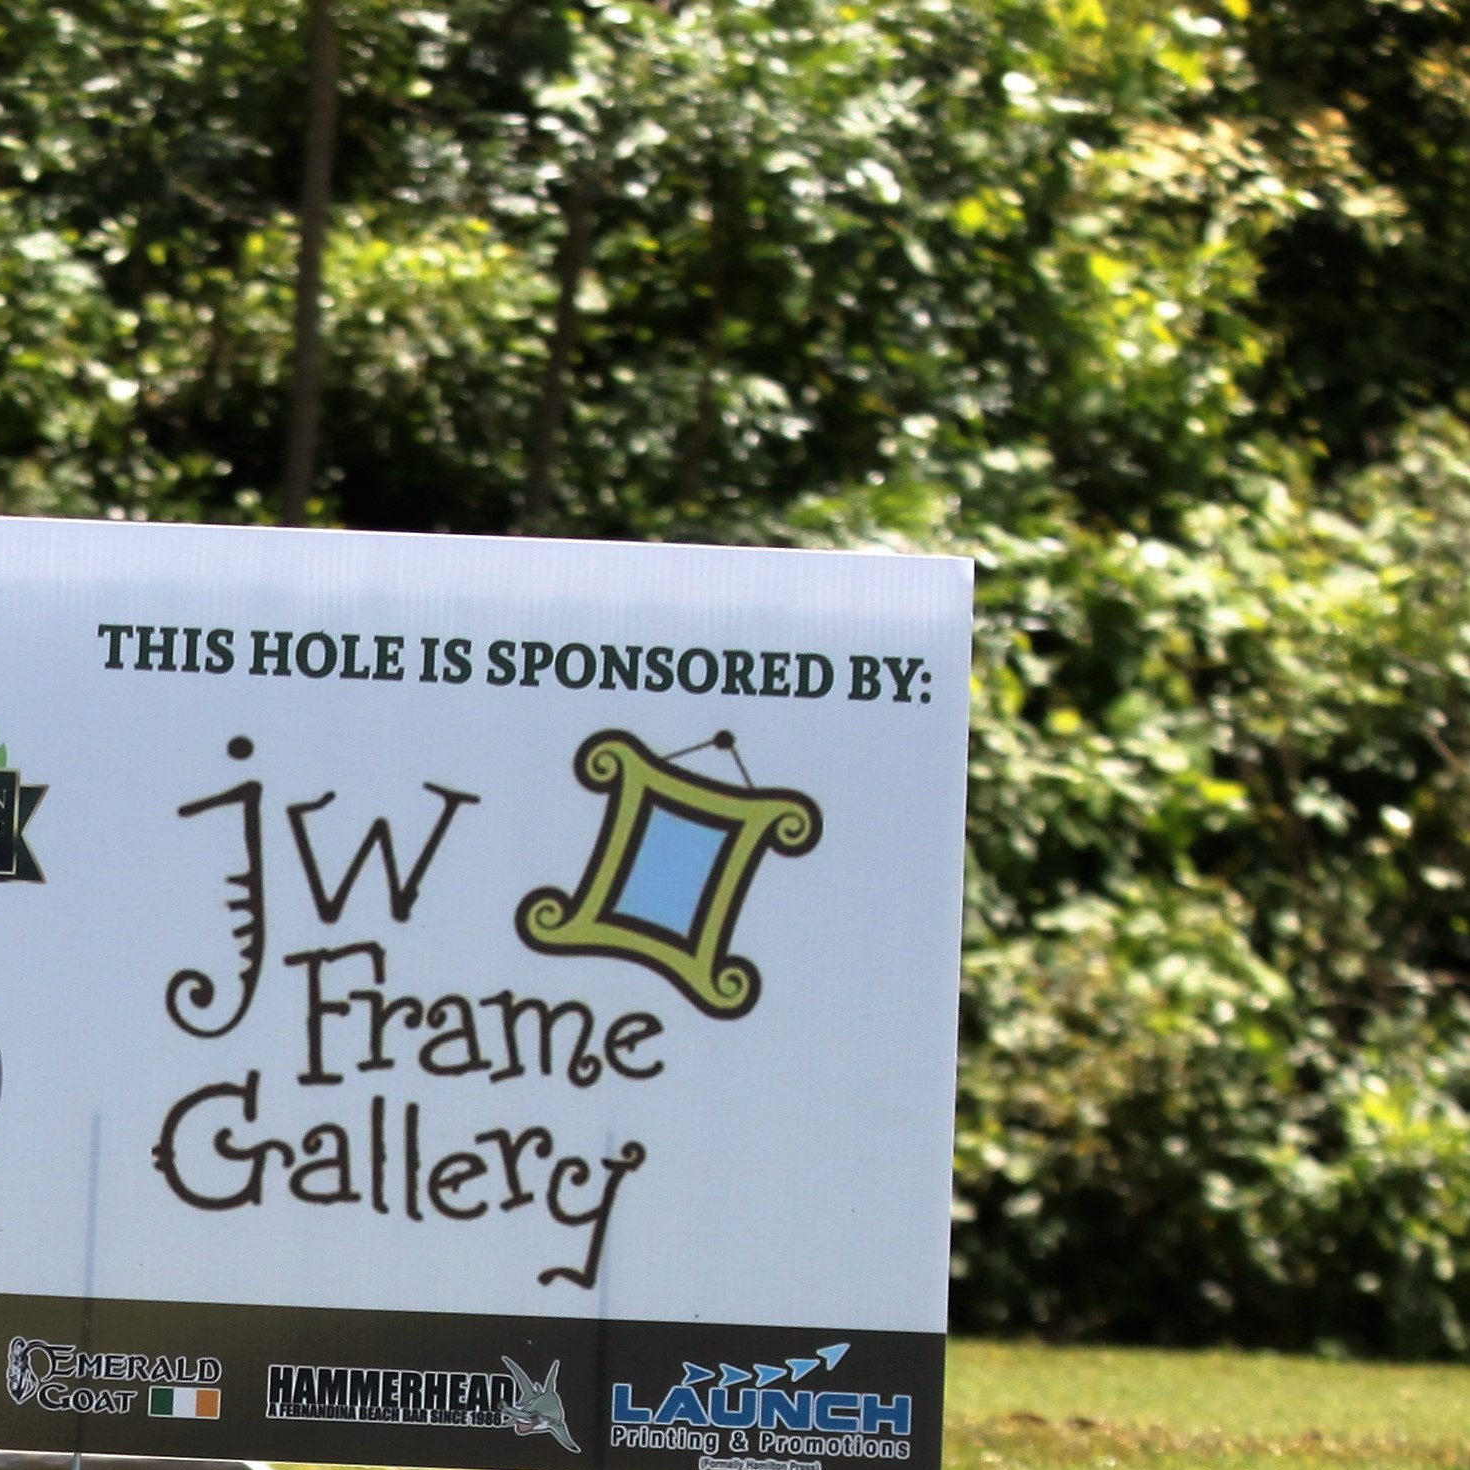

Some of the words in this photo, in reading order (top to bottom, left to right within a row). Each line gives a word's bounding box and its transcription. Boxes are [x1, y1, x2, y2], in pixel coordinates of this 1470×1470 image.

[97, 624, 235, 673] THIS
[249, 629, 405, 681] HOLE
[419, 637, 472, 686] IS
[487, 641, 835, 700] SPONSORED
[849, 654, 932, 705] BY:
[284, 942, 665, 1087] Frame
[152, 1069, 646, 1290] Gallery
[269, 1365, 516, 1411] HAMMERHEAD
[612, 1383, 912, 1435] LAUNCH
[267, 1403, 278, 1417] A
[280, 1404, 356, 1420] FERNANDINA
[359, 1406, 400, 1422] BEACH
[403, 1408, 427, 1424] BAR
[430, 1410, 468, 1426] SINCE
[612, 1426, 719, 1455] Printing
[729, 1431, 749, 1452] &
[760, 1431, 910, 1459] Promotions
